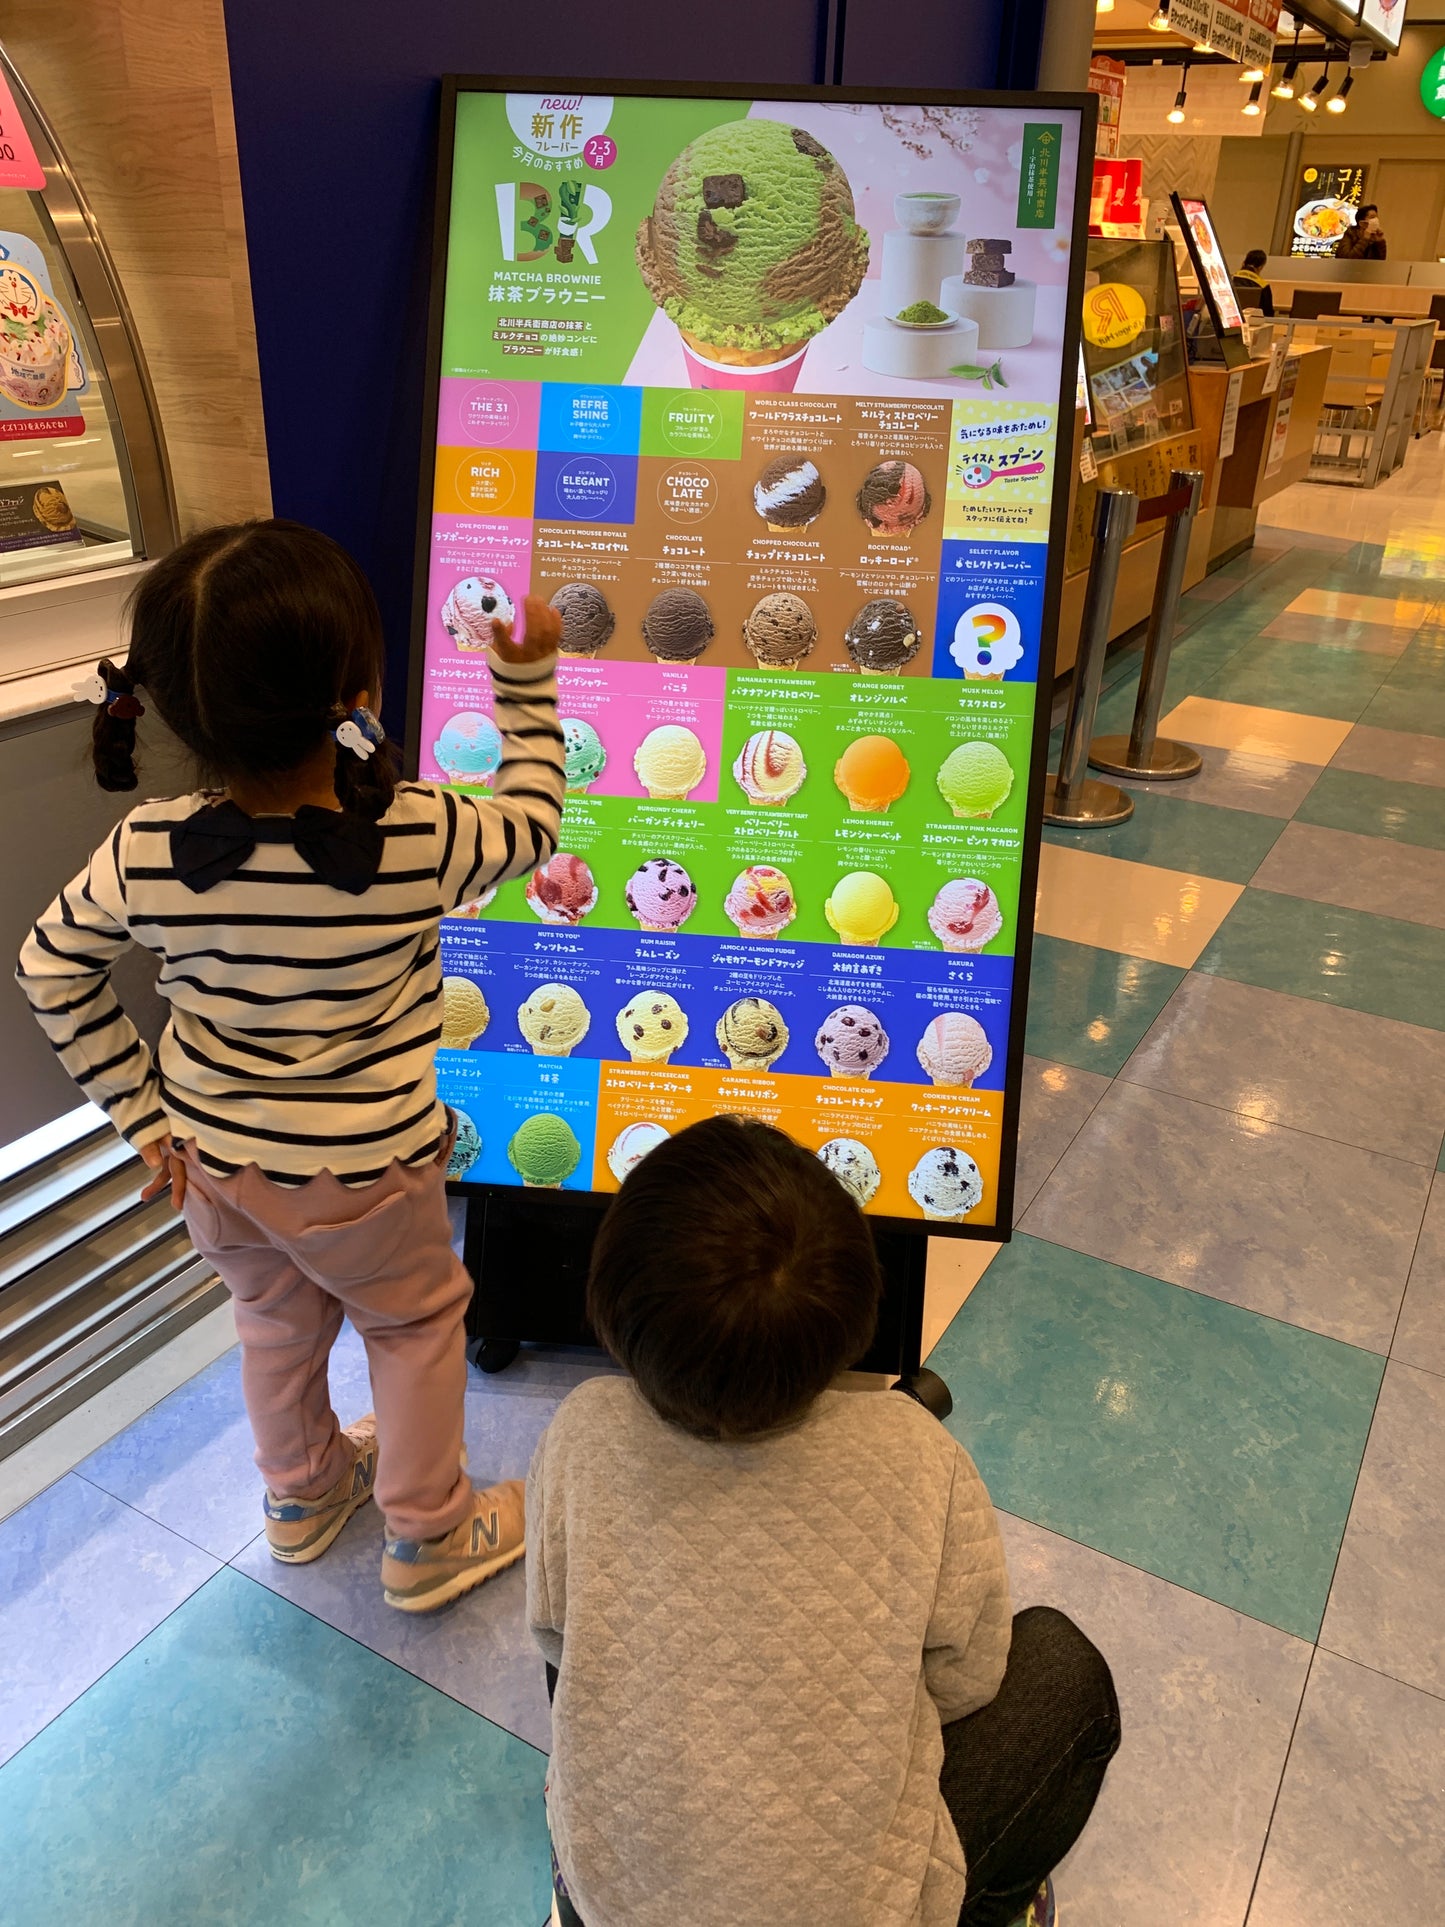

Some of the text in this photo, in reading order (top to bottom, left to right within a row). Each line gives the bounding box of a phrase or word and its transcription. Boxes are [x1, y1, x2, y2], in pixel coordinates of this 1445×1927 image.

[540, 94, 584, 110] new!
[531, 112, 583, 139] 新作
[535, 141, 578, 152] フレーバー
[511, 145, 584, 172] 今月のおすすめ
[595, 155, 603, 165] 月
[493, 272, 601, 284] MATCHA BROWNIE
[488, 285, 605, 305] 抹茶ブラウニー
[470, 402, 508, 411] THE 31
[572, 399, 608, 409] REFRE
[572, 410, 608, 420] SHING
[668, 413, 714, 423] FRUITY
[749, 410, 842, 423] ワールドクラスチョコレート
[861, 410, 938, 421] メルティ ストロベリー
[878, 421, 919, 430] チョコレート
[960, 417, 1045, 442] 気になる味をおためし!
[962, 446, 1043, 469] テイスト スプーン
[470, 467, 499, 477] RICH
[562, 475, 609, 486] ELEGANT
[666, 476, 709, 487] CHOCO
[672, 488, 703, 498] LATE
[962, 505, 1032, 514] ためしたいフレーバーを
[966, 514, 1027, 523] スタッフに伝えてね!
[435, 531, 529, 545] ラブポーションサーティワン
[536, 538, 629, 552] チョコレートムースロイヤル
[662, 545, 705, 556] チョコレート
[746, 549, 825, 562] チョップドチョコレート
[964, 559, 1031, 571] セレクトフレーバー
[662, 682, 687, 692] バニラ
[731, 686, 820, 700] バナナアンドストロベリー
[849, 693, 907, 705] オレンジソルベ
[958, 698, 1006, 709] マスクメロン
[627, 814, 705, 829] バーガンディチェリー
[744, 818, 789, 827] ベリーベリー
[925, 823, 968, 831] STRAWBERRY
[734, 826, 799, 838] ストロベリータルト
[834, 829, 901, 841] レモンシャーベット
[922, 834, 1020, 847] ストロベリー ピンク マカロン
[533, 942, 584, 953] ナッツトゥユー
[634, 948, 680, 960] ラムレーズン
[832, 951, 864, 959] DAINAGON
[711, 953, 804, 969] ジャモカアーモンドファッジ
[832, 961, 882, 975] 大納言あずき
[948, 971, 973, 981] さくら
[539, 1072, 559, 1084] 抹茶
[608, 1068, 689, 1079] STRAWBERRY CHEESECAKE
[605, 1077, 692, 1093] ストロベリーチーズケーキ
[722, 1076, 751, 1084] CARAMEL
[717, 1086, 778, 1100] キャラメルリボン
[822, 1084, 859, 1092] CHOCOLATE
[815, 1093, 883, 1108] チョコレートチップ
[911, 1102, 991, 1117] クッキーアンドクリーム
[351, 1452, 373, 1498] N
[469, 1508, 499, 1558] N
